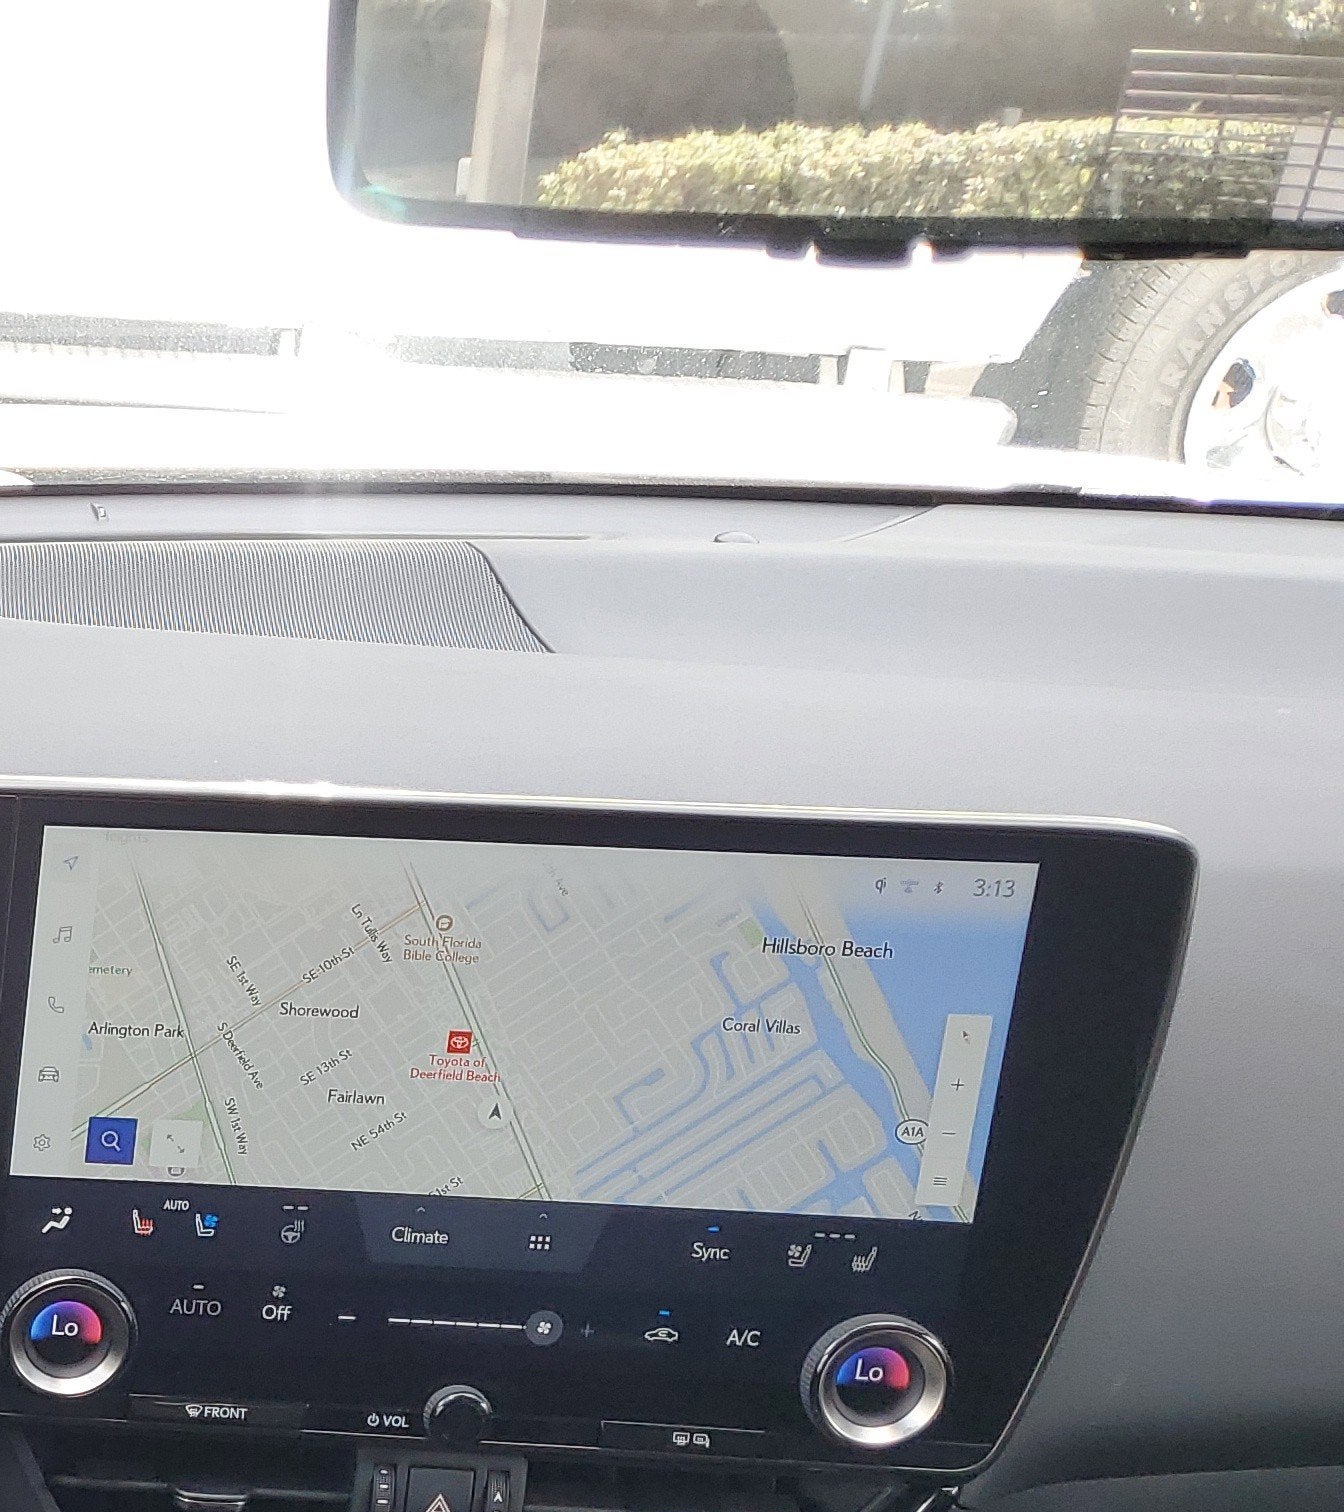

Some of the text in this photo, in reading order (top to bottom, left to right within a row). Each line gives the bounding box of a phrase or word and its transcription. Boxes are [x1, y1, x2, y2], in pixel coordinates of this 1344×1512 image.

[973, 878, 1016, 898] 3:13
[404, 934, 482, 949] South Florida
[762, 937, 894, 960] Hillsboro Beach
[376, 940, 393, 963] Way
[403, 949, 479, 964] Bible College
[302, 946, 355, 984] SE 10th St
[227, 955, 241, 972] SE
[245, 983, 262, 1007] Way
[279, 1001, 360, 1019] Shorewood
[88, 1021, 185, 1039] Arlington Park
[721, 1017, 801, 1036] Coral Villas
[222, 1030, 253, 1072] Deerfield
[247, 1069, 263, 1090] Ave
[300, 1048, 353, 1086] SE 13th St
[429, 1053, 487, 1069] Toyota of
[409, 1068, 501, 1083] Deerfield Beach
[327, 1088, 385, 1105] Fairlawn
[350, 1111, 408, 1152] NE 54th St
[900, 1126, 924, 1138] A1A
[236, 1132, 248, 1156] Way
[449, 1175, 464, 1189] St
[163, 1199, 190, 1212] AUTO
[391, 1226, 449, 1246] Climate
[692, 1242, 731, 1262] Sync
[169, 1298, 222, 1318] AUTO
[261, 1303, 292, 1322] Off
[51, 1316, 79, 1338] Lo
[725, 1329, 761, 1347] A/C
[855, 1359, 884, 1383] Lo
[203, 1405, 247, 1420] FRONT
[383, 1414, 409, 1429] VOL
